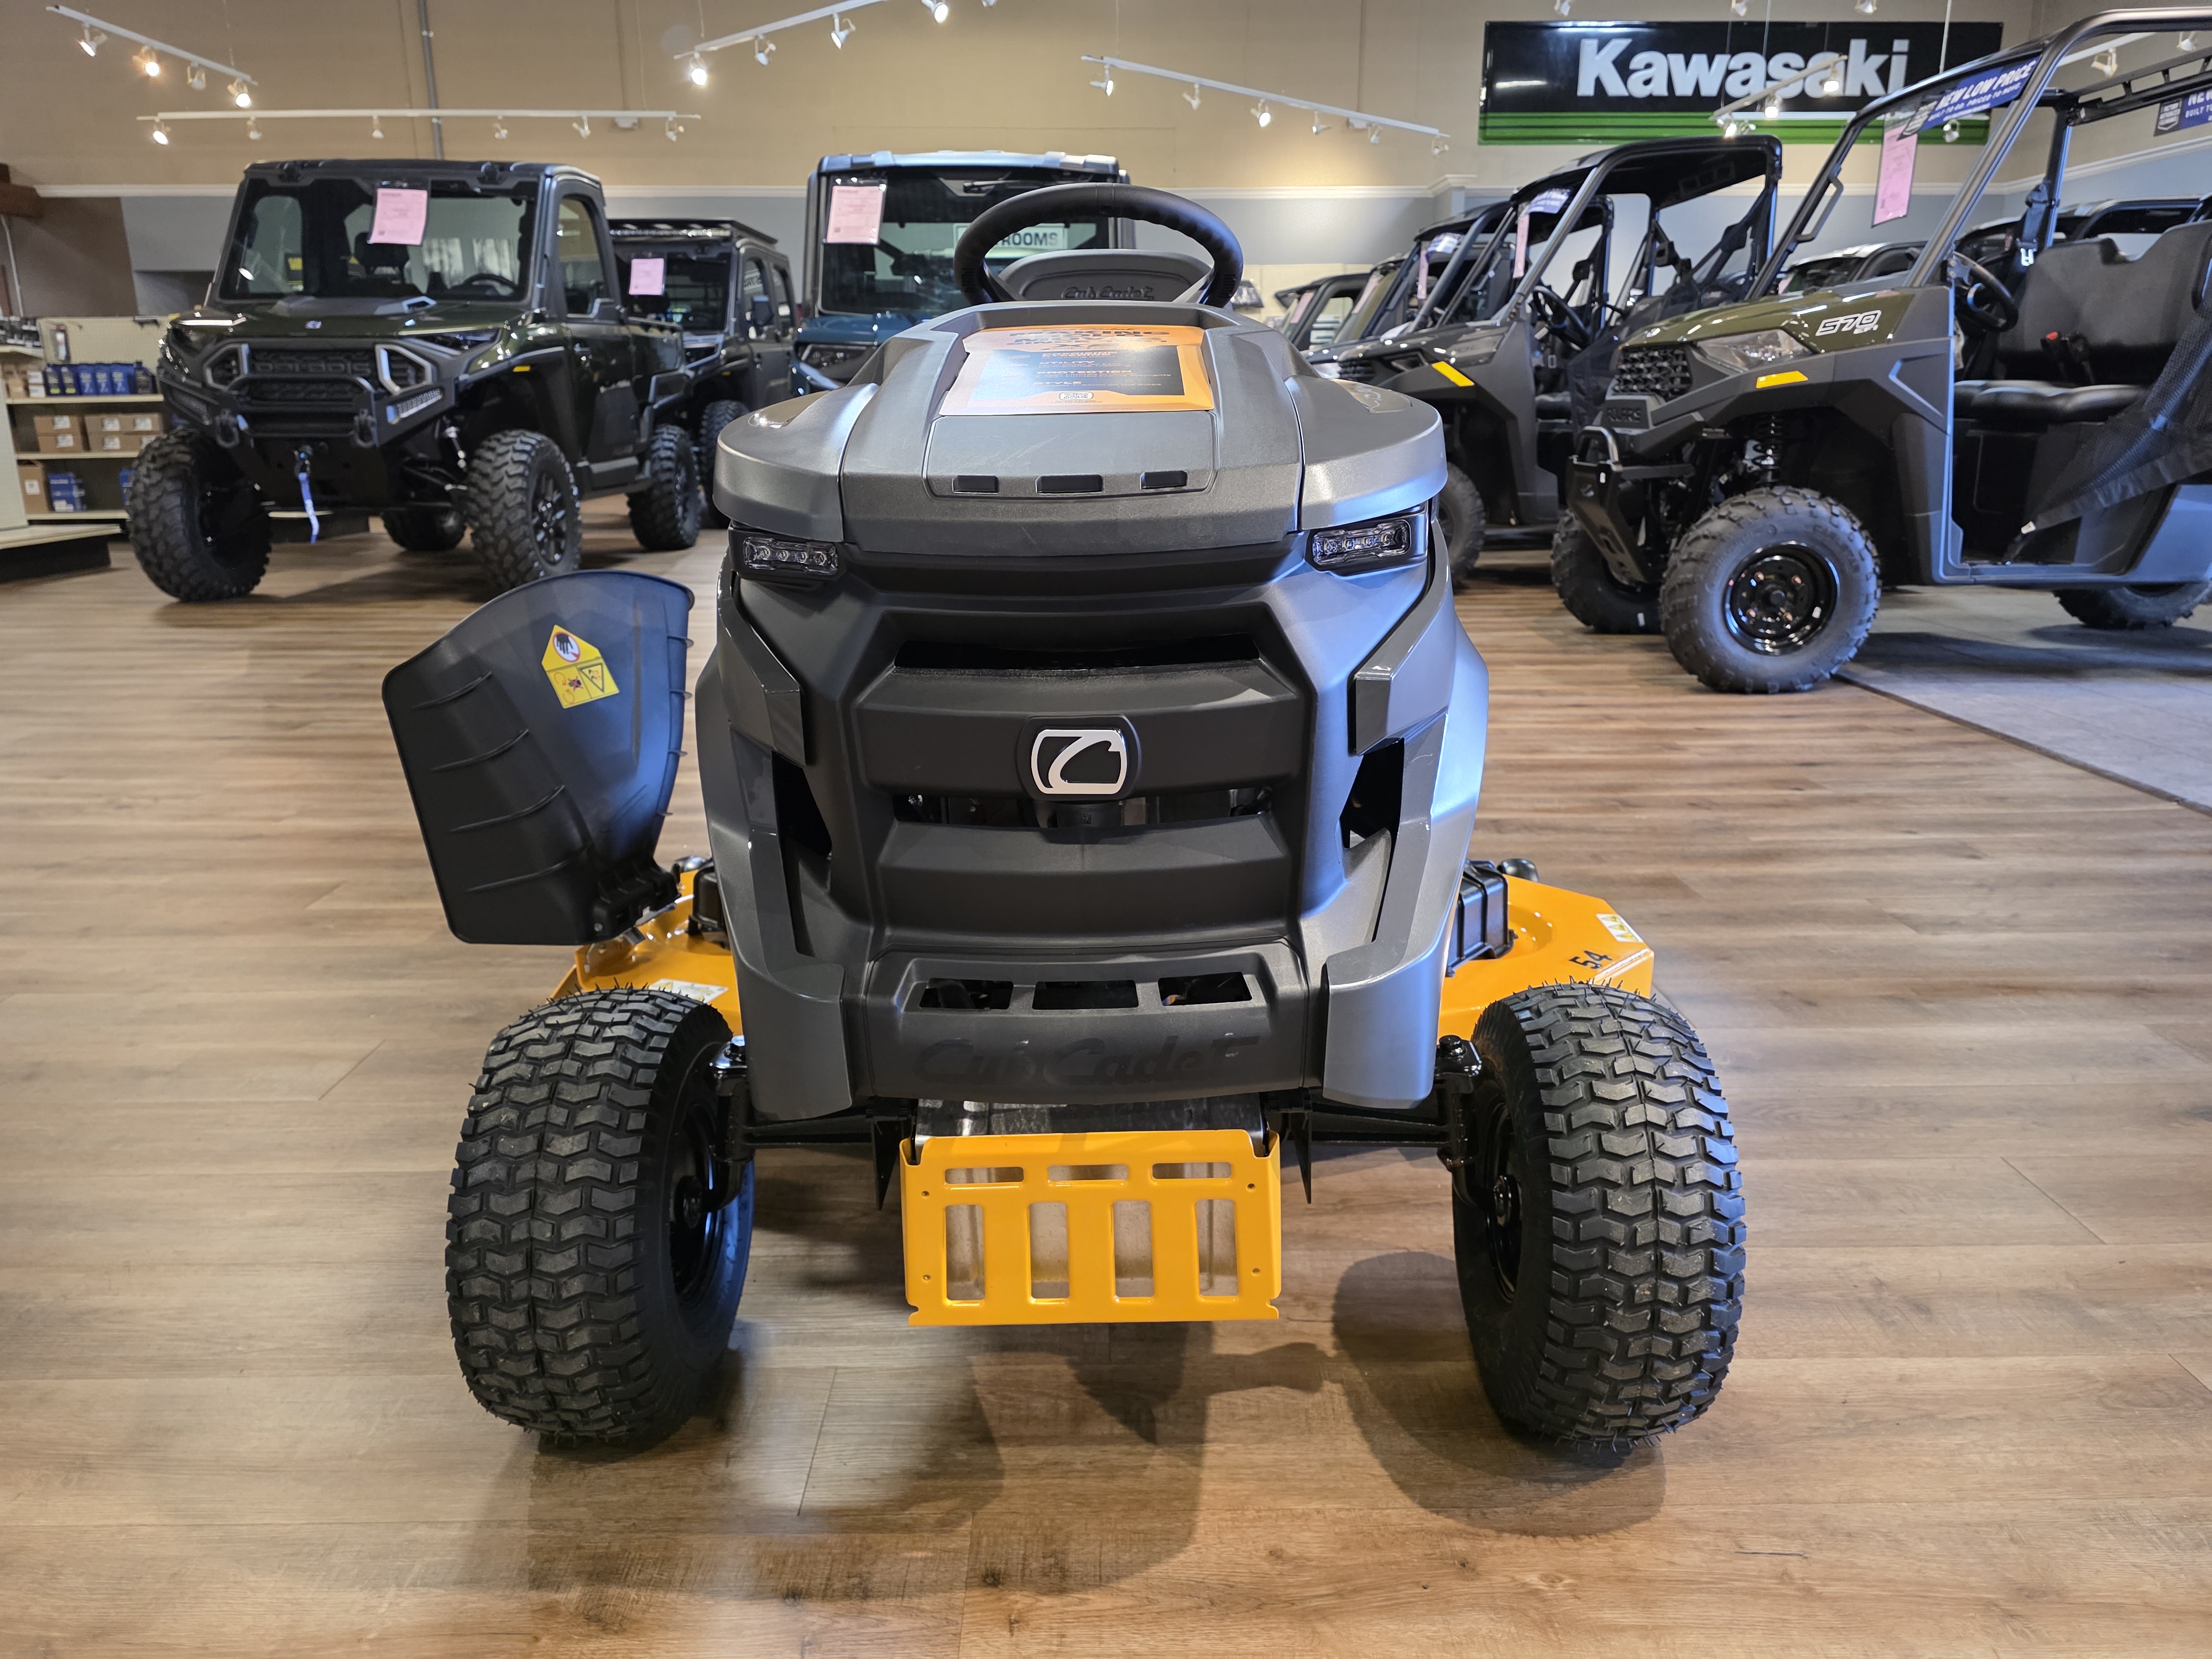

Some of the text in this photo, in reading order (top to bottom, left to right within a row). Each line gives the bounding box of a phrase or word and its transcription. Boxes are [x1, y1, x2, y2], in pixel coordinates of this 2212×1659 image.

[1577, 38, 1910, 98] Kawasaki
[1936, 59, 2037, 111] NEW LOW PRICE
[1815, 310, 1881, 336] 570
[1569, 950, 1613, 969] 54
